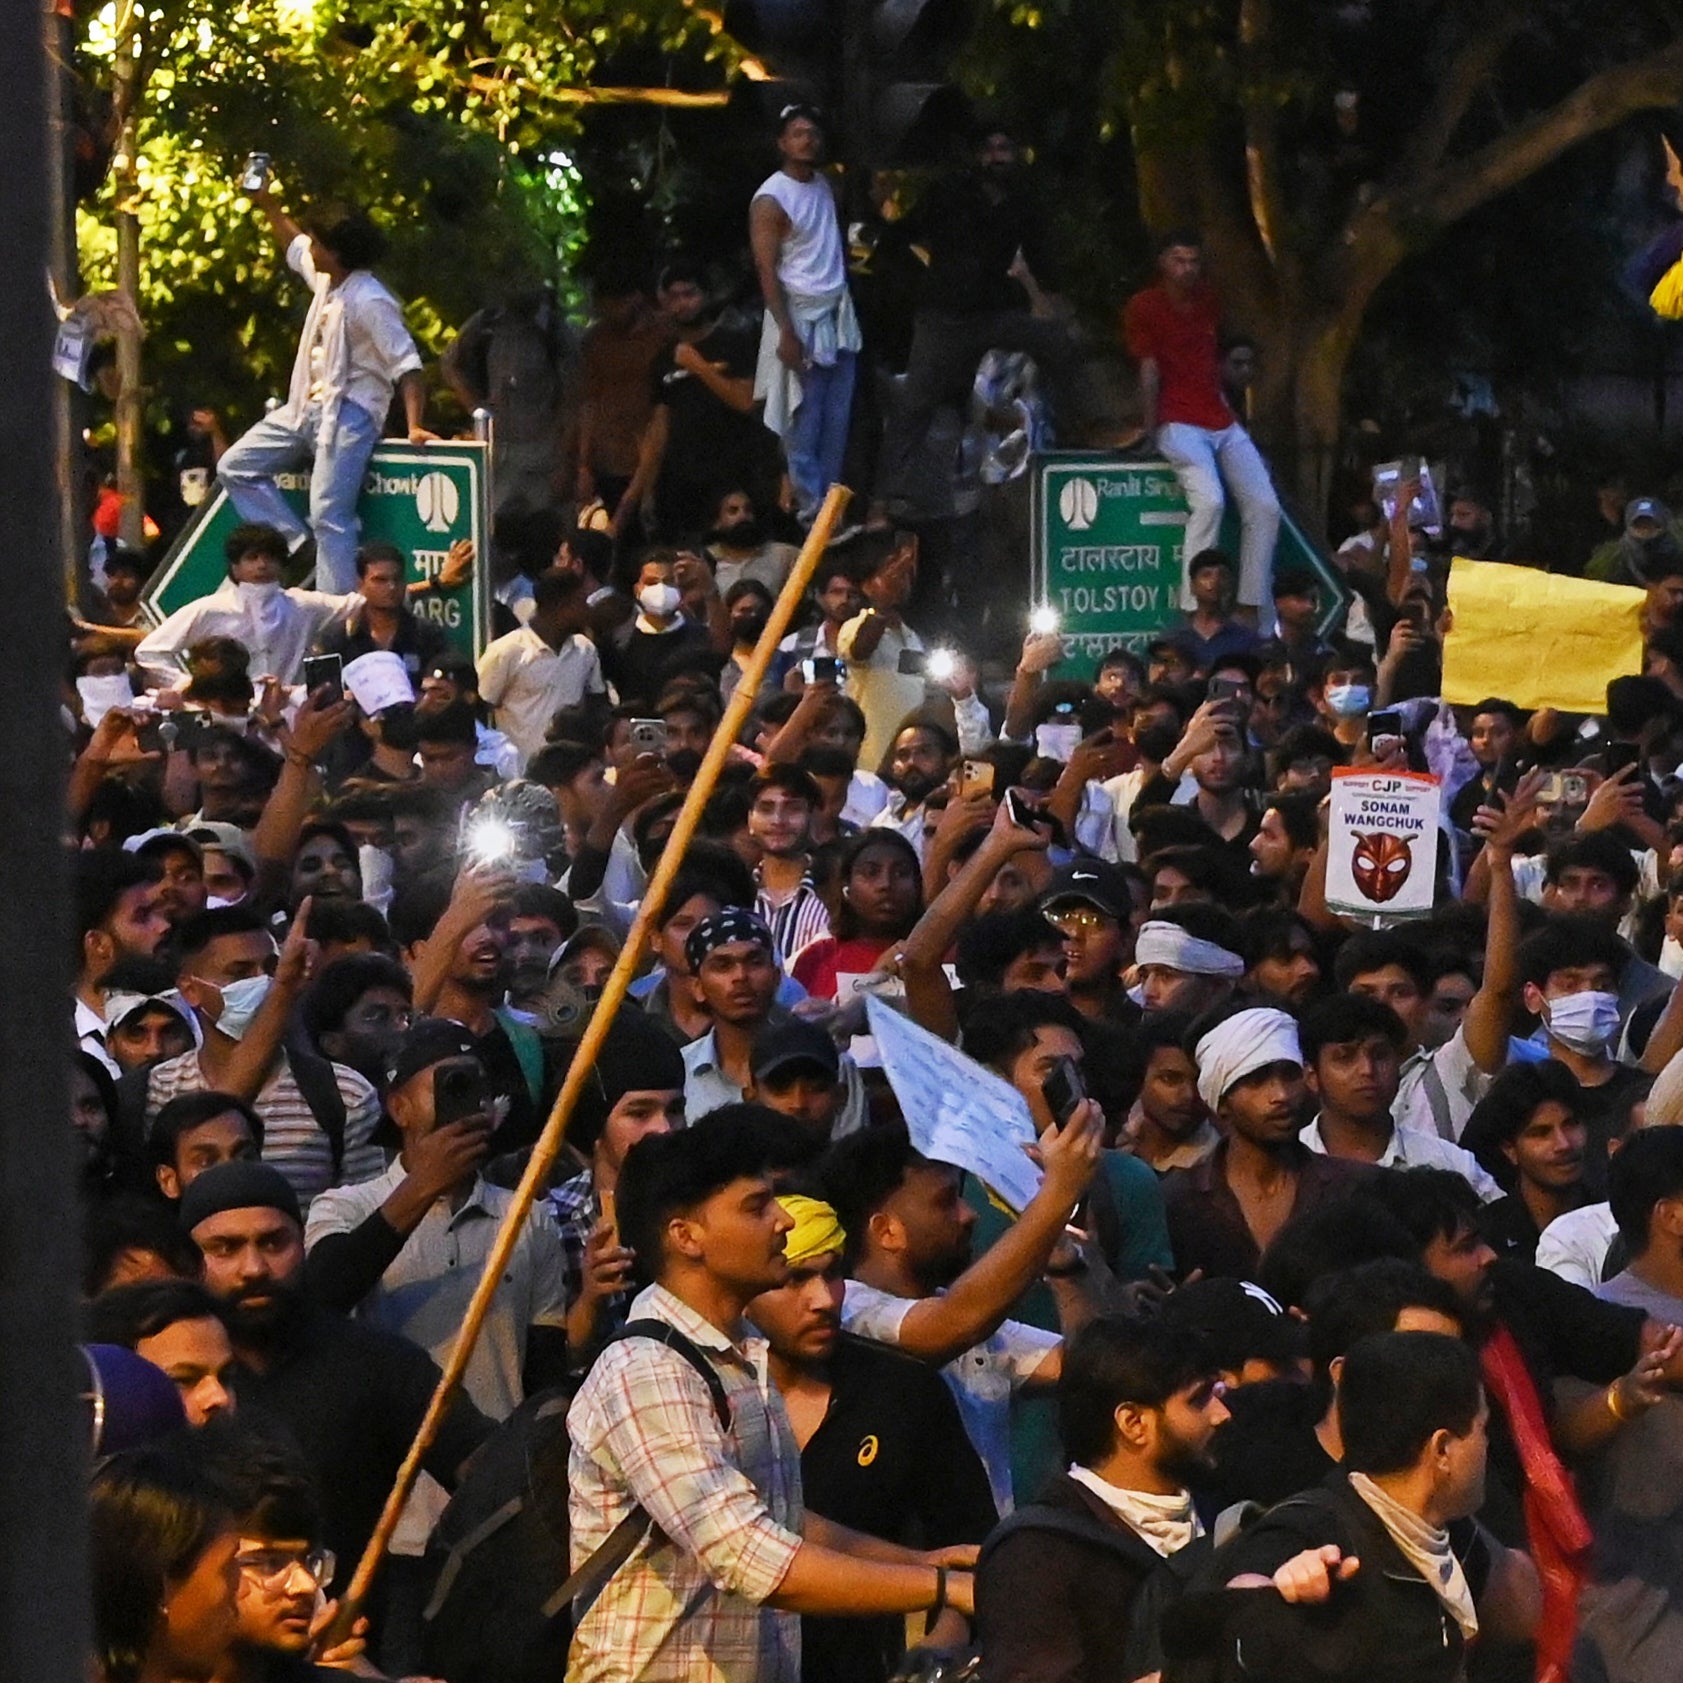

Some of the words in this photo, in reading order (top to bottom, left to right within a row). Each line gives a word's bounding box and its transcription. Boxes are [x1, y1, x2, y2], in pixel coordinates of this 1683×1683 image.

[1060, 584, 1159, 613] TOLSTOY
[406, 597, 461, 628] ARG
[1372, 779, 1402, 793] CJP
[1361, 800, 1410, 814] SONAM
[1344, 813, 1425, 830] WANGCHUK
